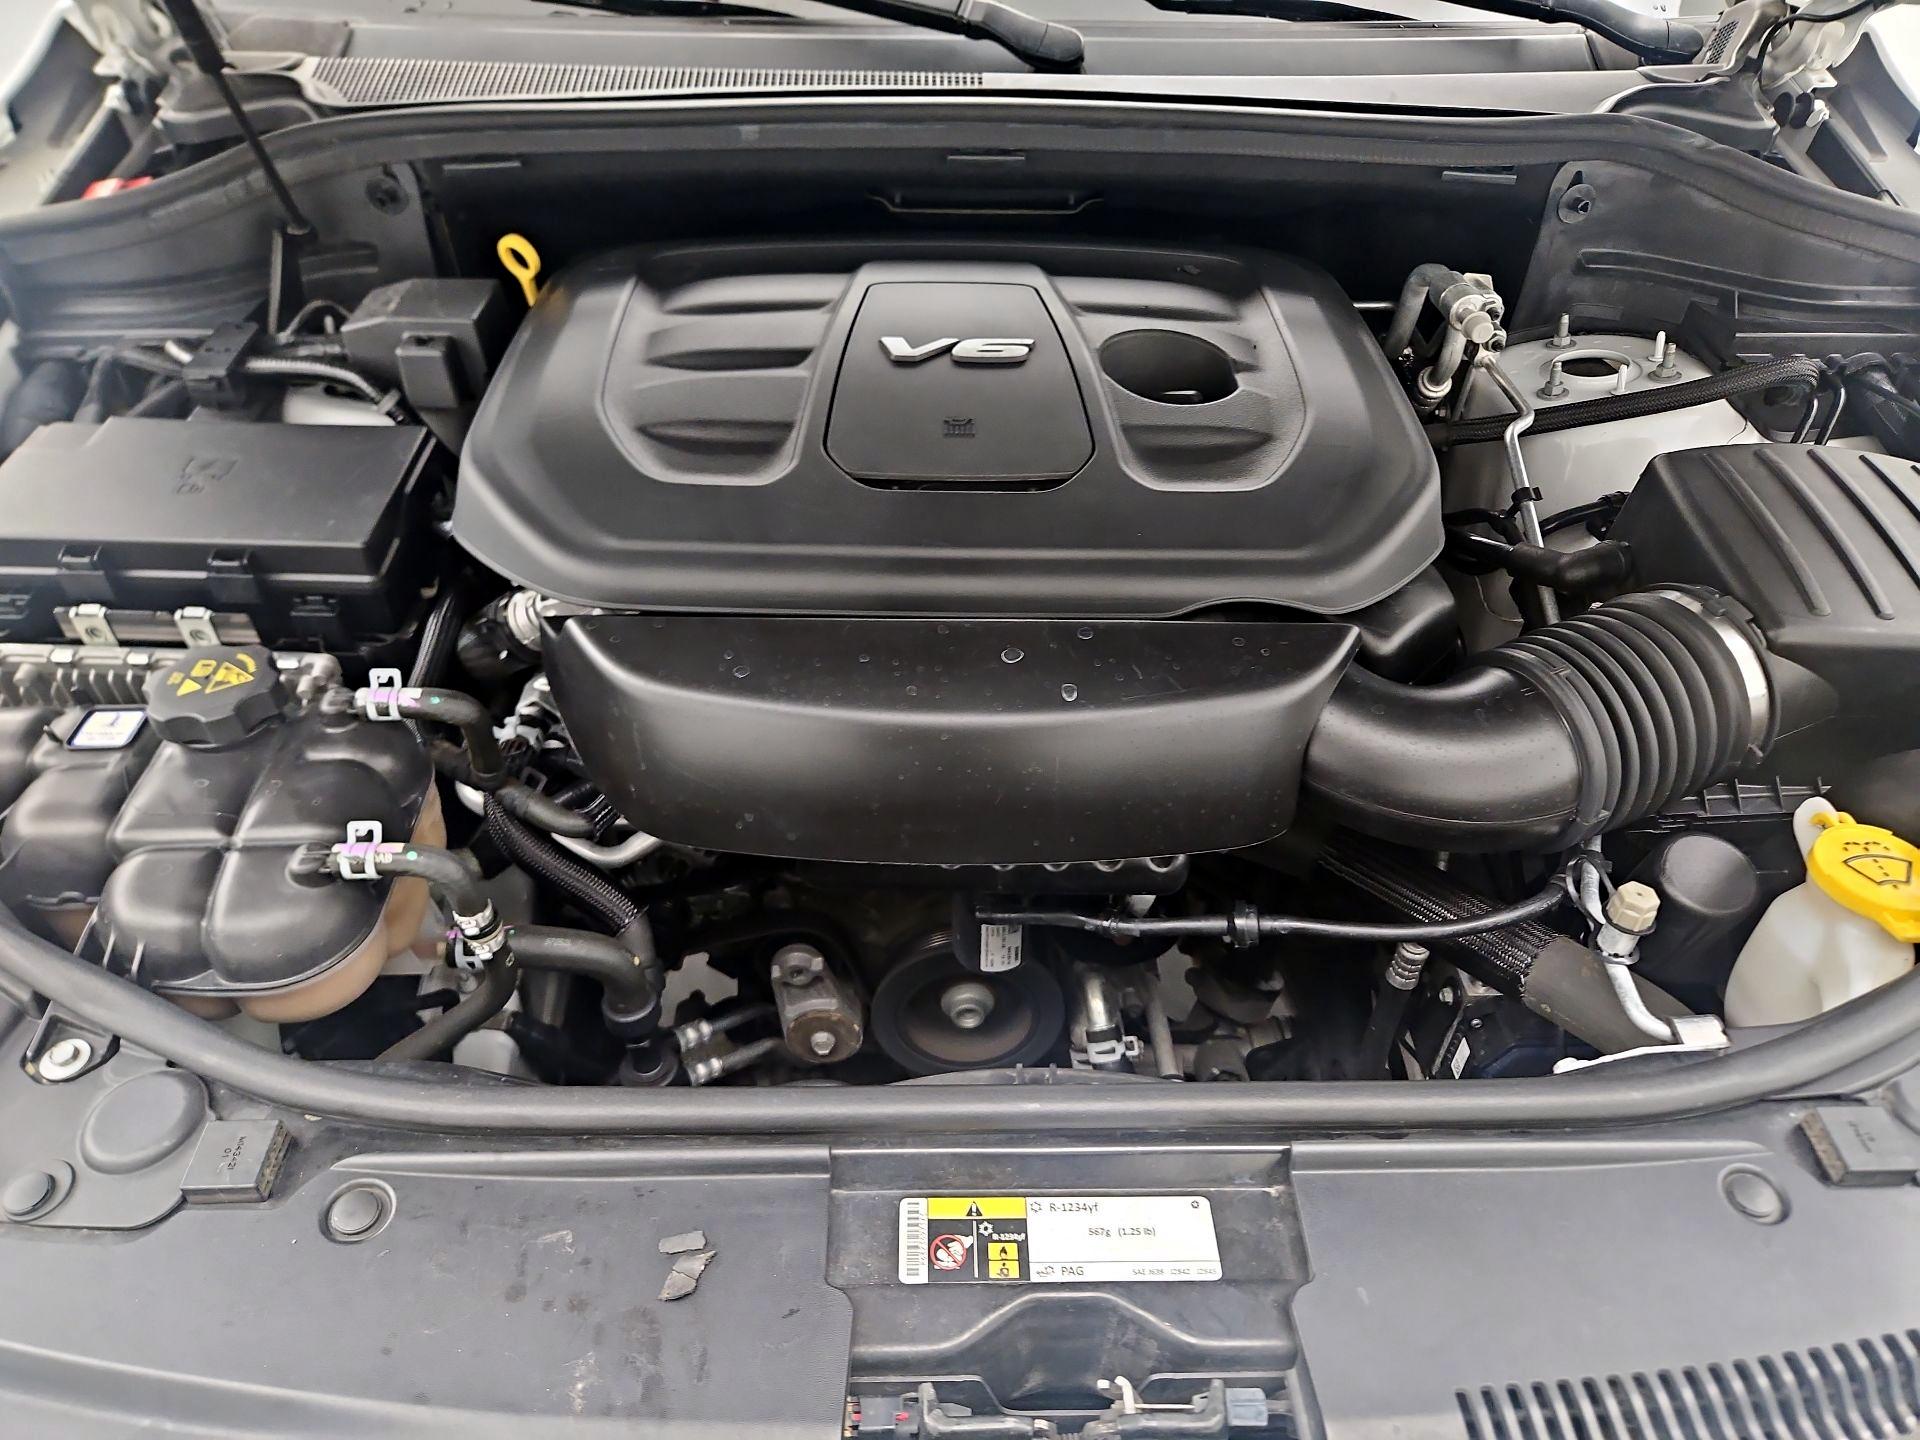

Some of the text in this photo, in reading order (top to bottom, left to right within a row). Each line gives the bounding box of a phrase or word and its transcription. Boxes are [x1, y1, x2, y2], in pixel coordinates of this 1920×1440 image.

[879, 336, 1036, 363] V6
[1049, 1202, 1099, 1215] R-1234yf
[1061, 1266, 1085, 1276] PAG
